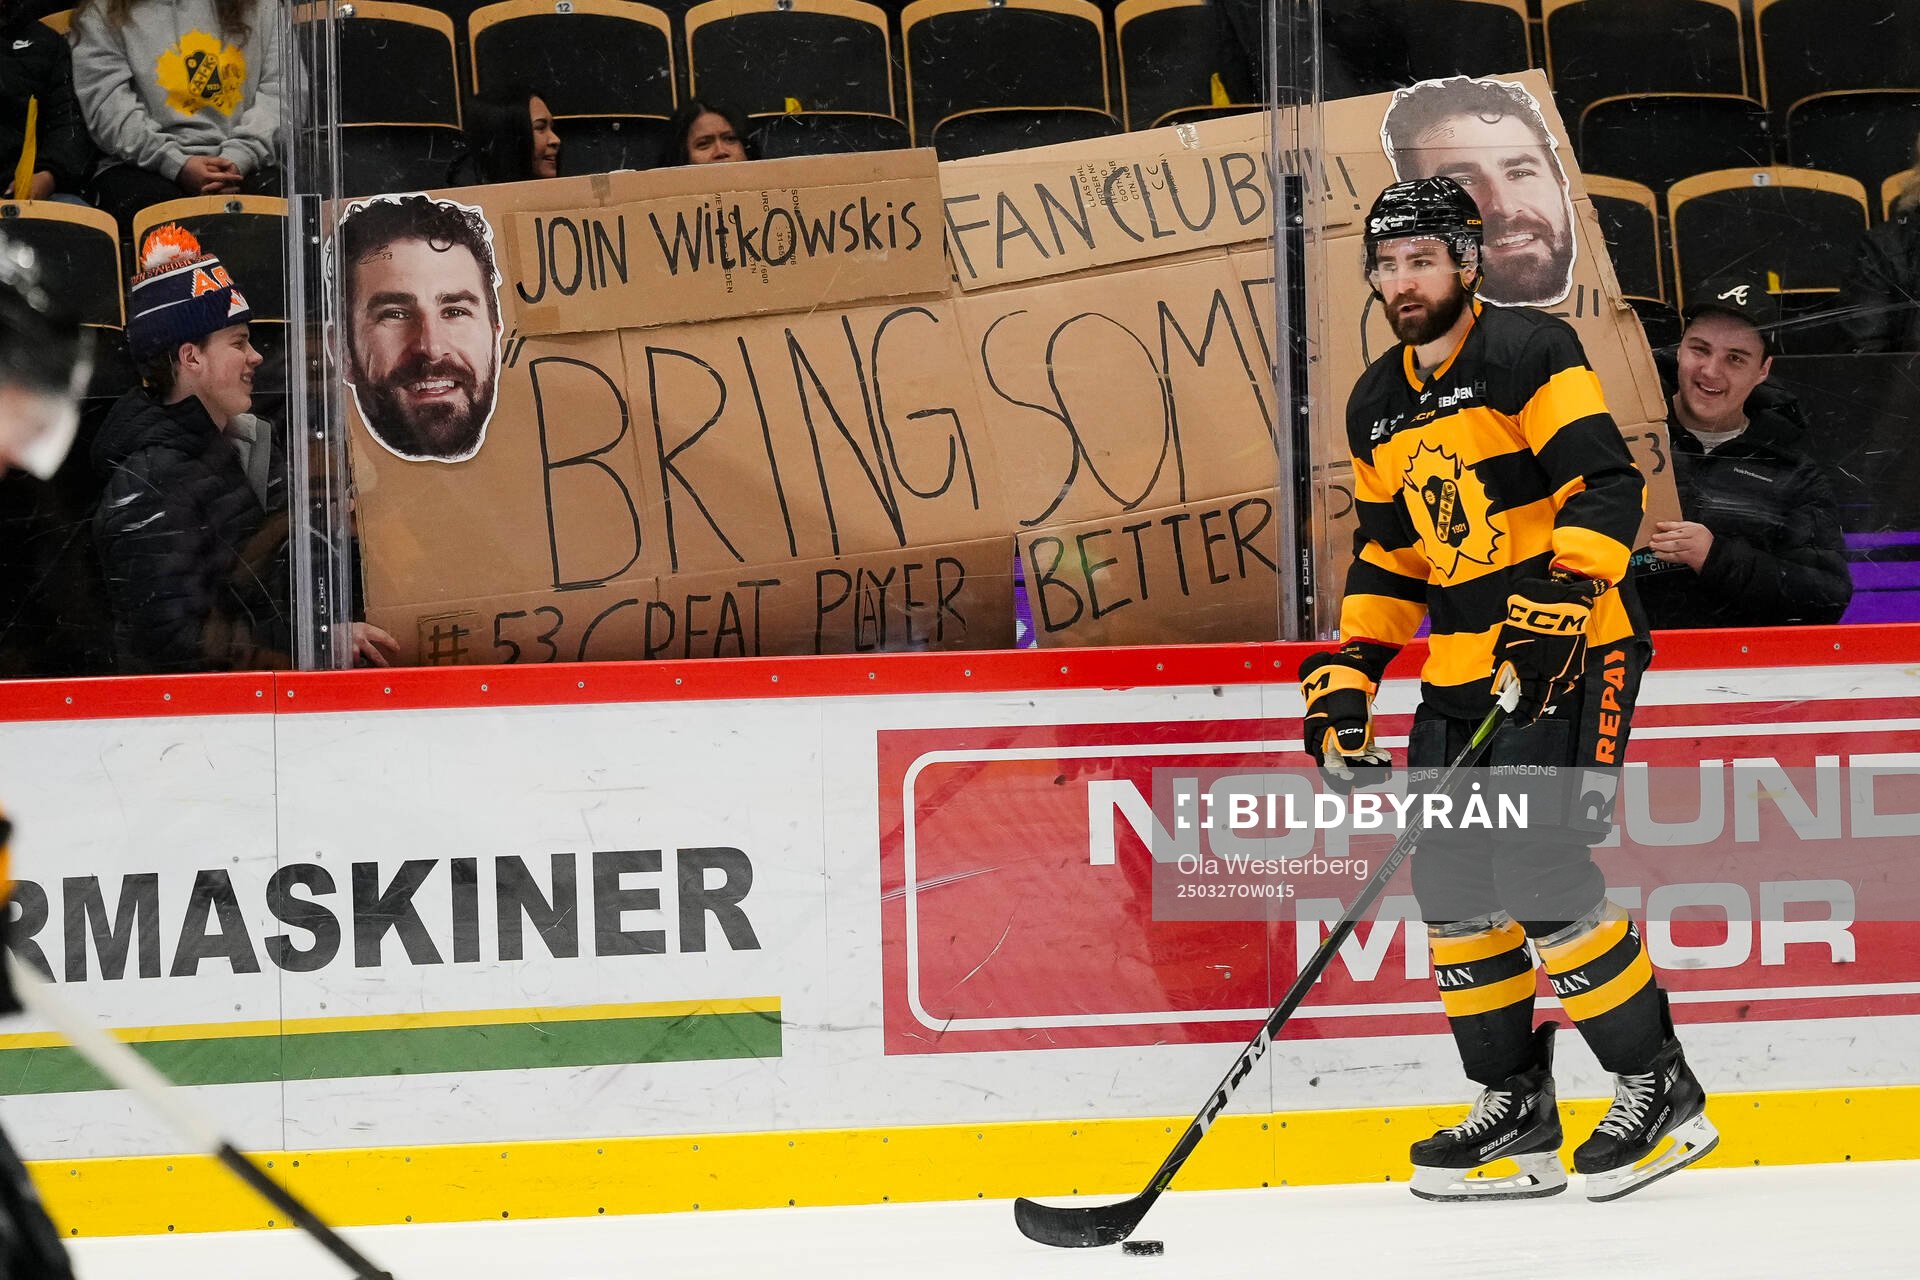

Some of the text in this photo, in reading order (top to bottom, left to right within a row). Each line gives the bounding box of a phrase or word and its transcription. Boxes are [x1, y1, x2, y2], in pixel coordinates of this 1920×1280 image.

[557, 3, 570, 12] 12
[516, 215, 628, 304] JOIN
[1451, 523, 1467, 535] 1921
[1029, 497, 1282, 633] BETTER
[1509, 604, 1587, 631] CCM
[1338, 728, 1364, 737] CCM
[1296, 879, 1856, 983] MOR
